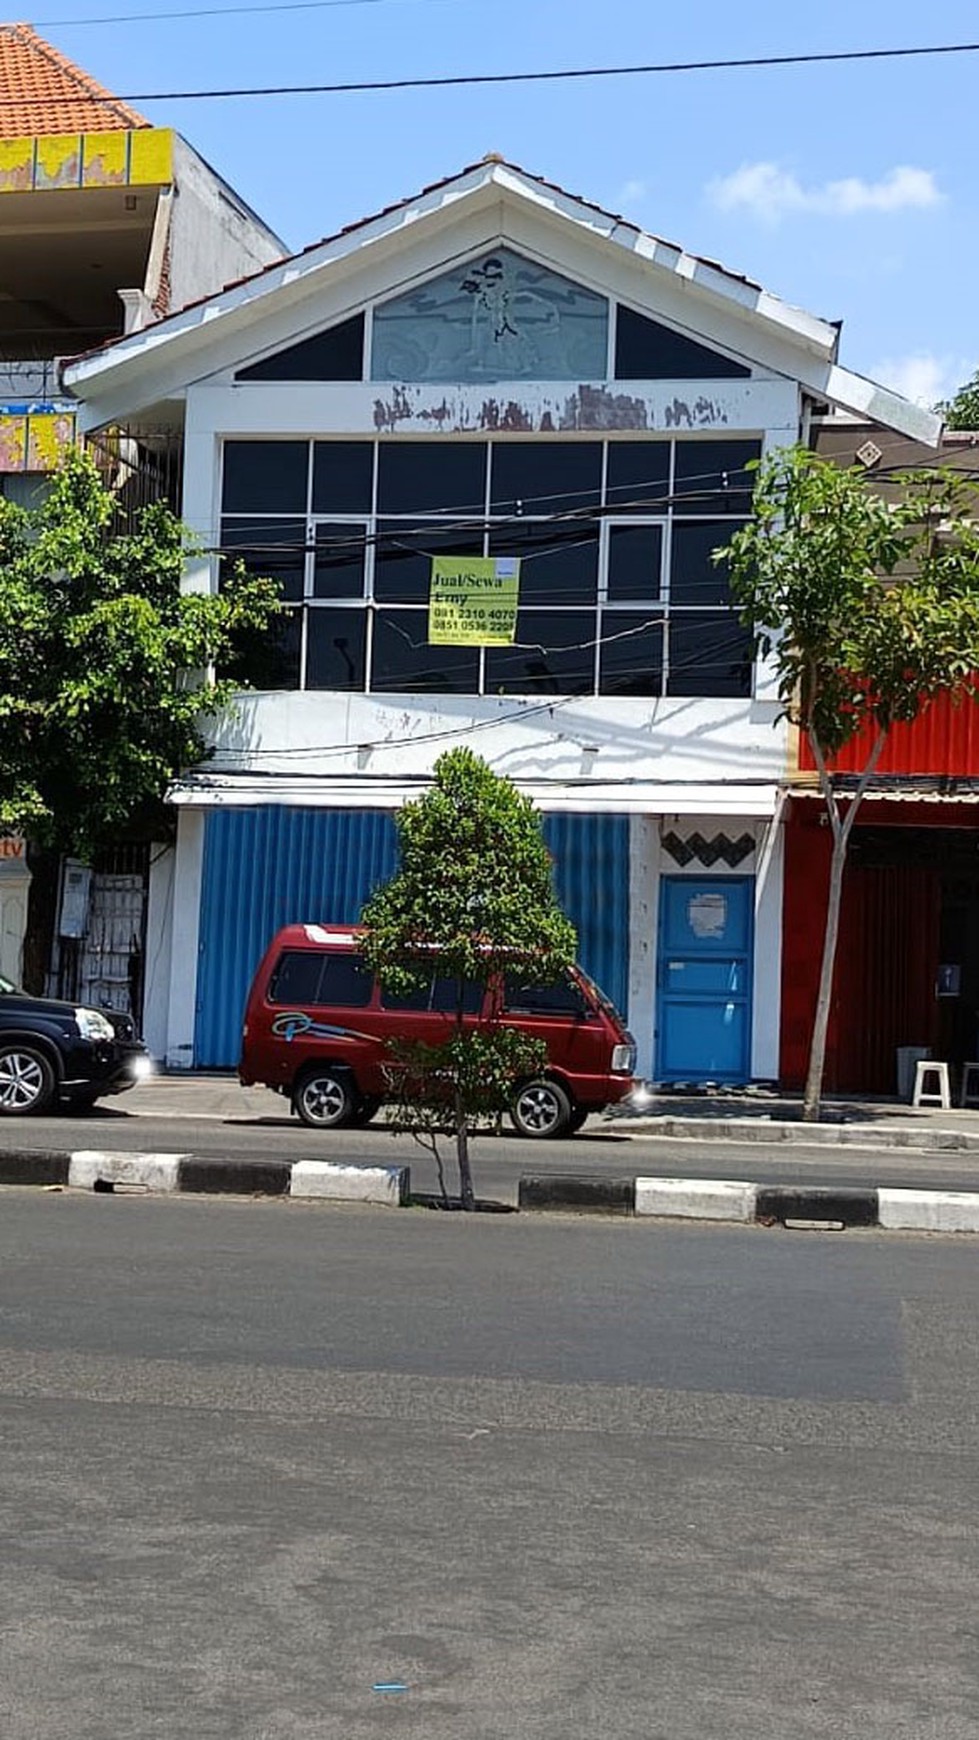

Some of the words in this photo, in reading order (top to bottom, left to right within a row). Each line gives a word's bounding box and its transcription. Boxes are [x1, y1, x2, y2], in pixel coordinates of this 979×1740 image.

[433, 573, 503, 588] Jual/Sewa
[458, 608, 486, 619] 2310
[488, 608, 516, 620] 4070
